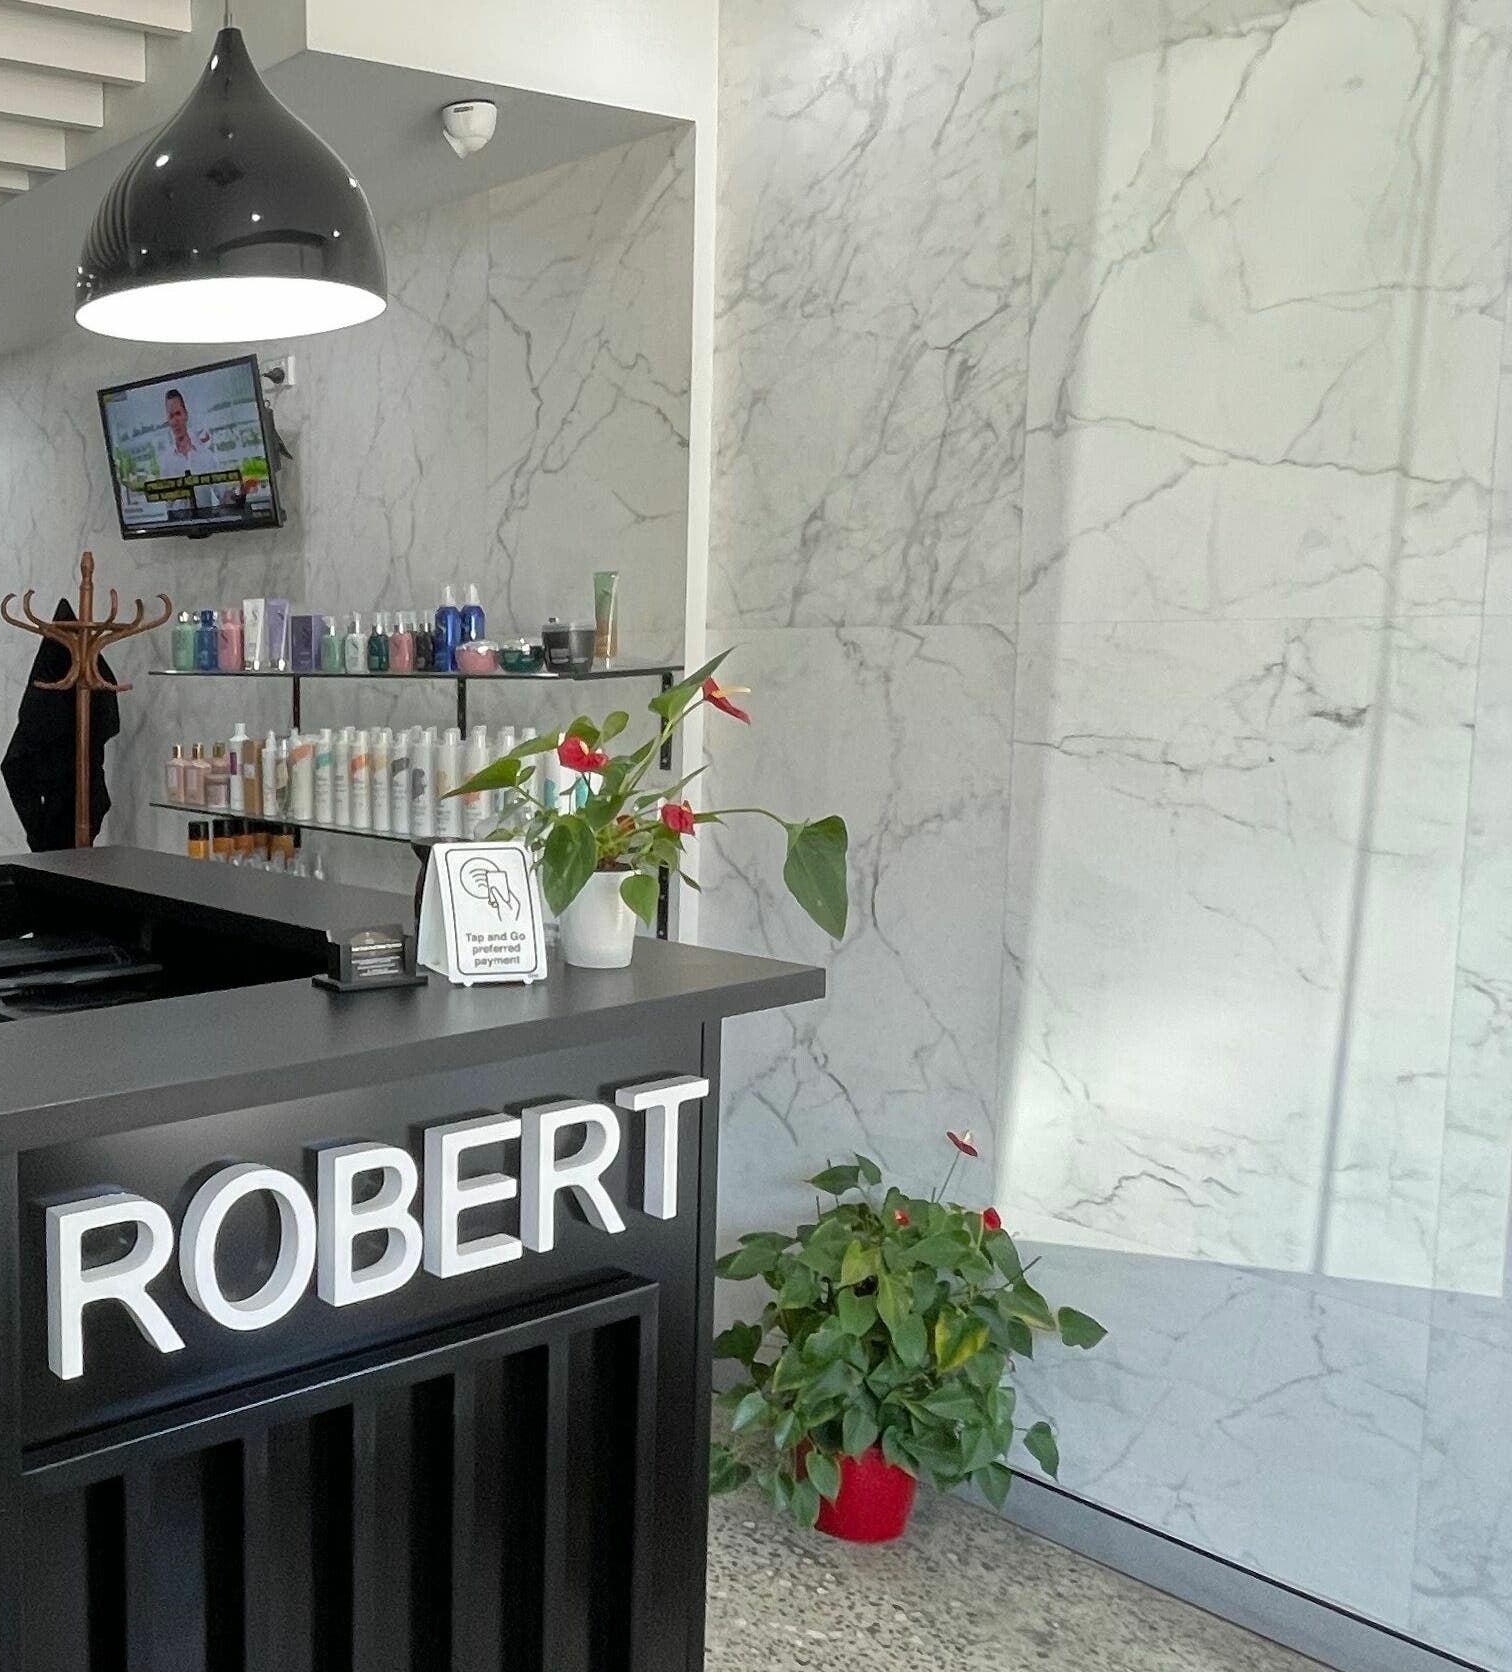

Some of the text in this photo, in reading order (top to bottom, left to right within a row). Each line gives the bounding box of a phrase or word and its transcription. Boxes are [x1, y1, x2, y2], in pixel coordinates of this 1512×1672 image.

[465, 931, 526, 943] Tap and Go
[472, 944, 521, 956] preferred
[474, 956, 520, 968] payment
[45, 1074, 710, 1381] ROBERT
